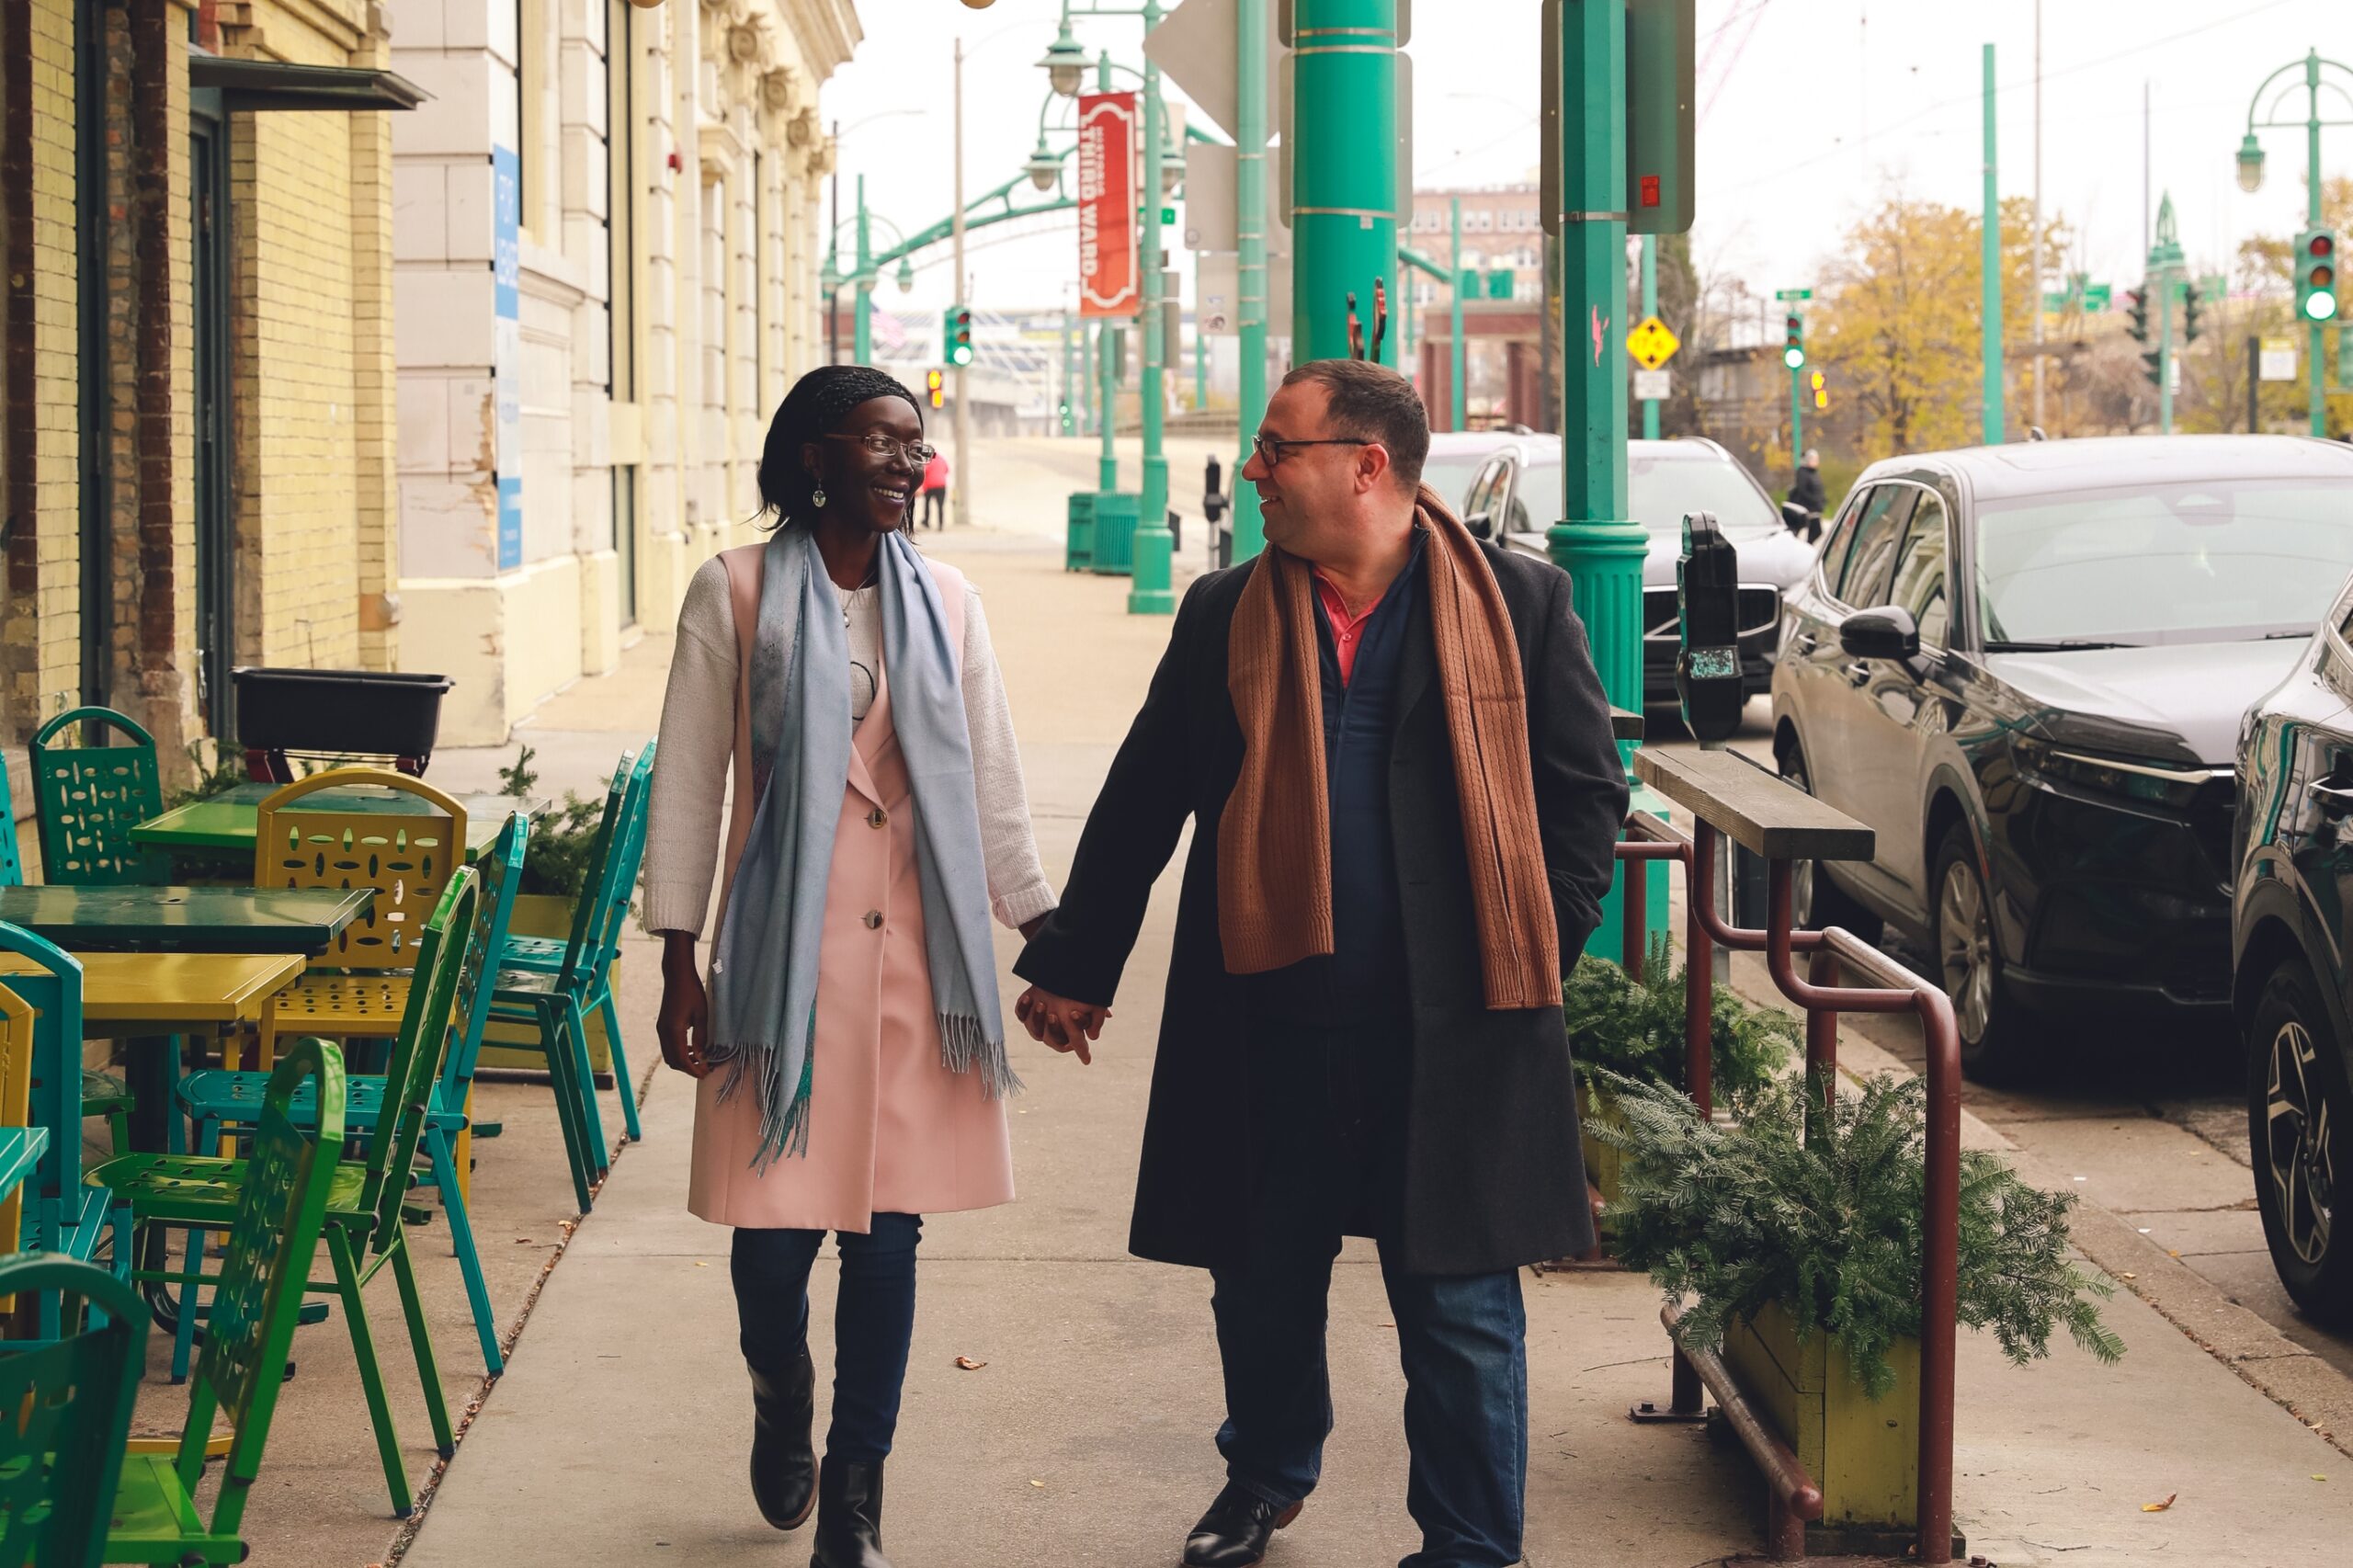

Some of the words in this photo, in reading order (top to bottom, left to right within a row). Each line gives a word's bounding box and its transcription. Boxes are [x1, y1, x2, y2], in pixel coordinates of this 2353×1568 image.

[1081, 125, 1097, 201] THIRD
[1097, 126, 1105, 197] HISTORIC
[1081, 203, 1098, 276] WARD
